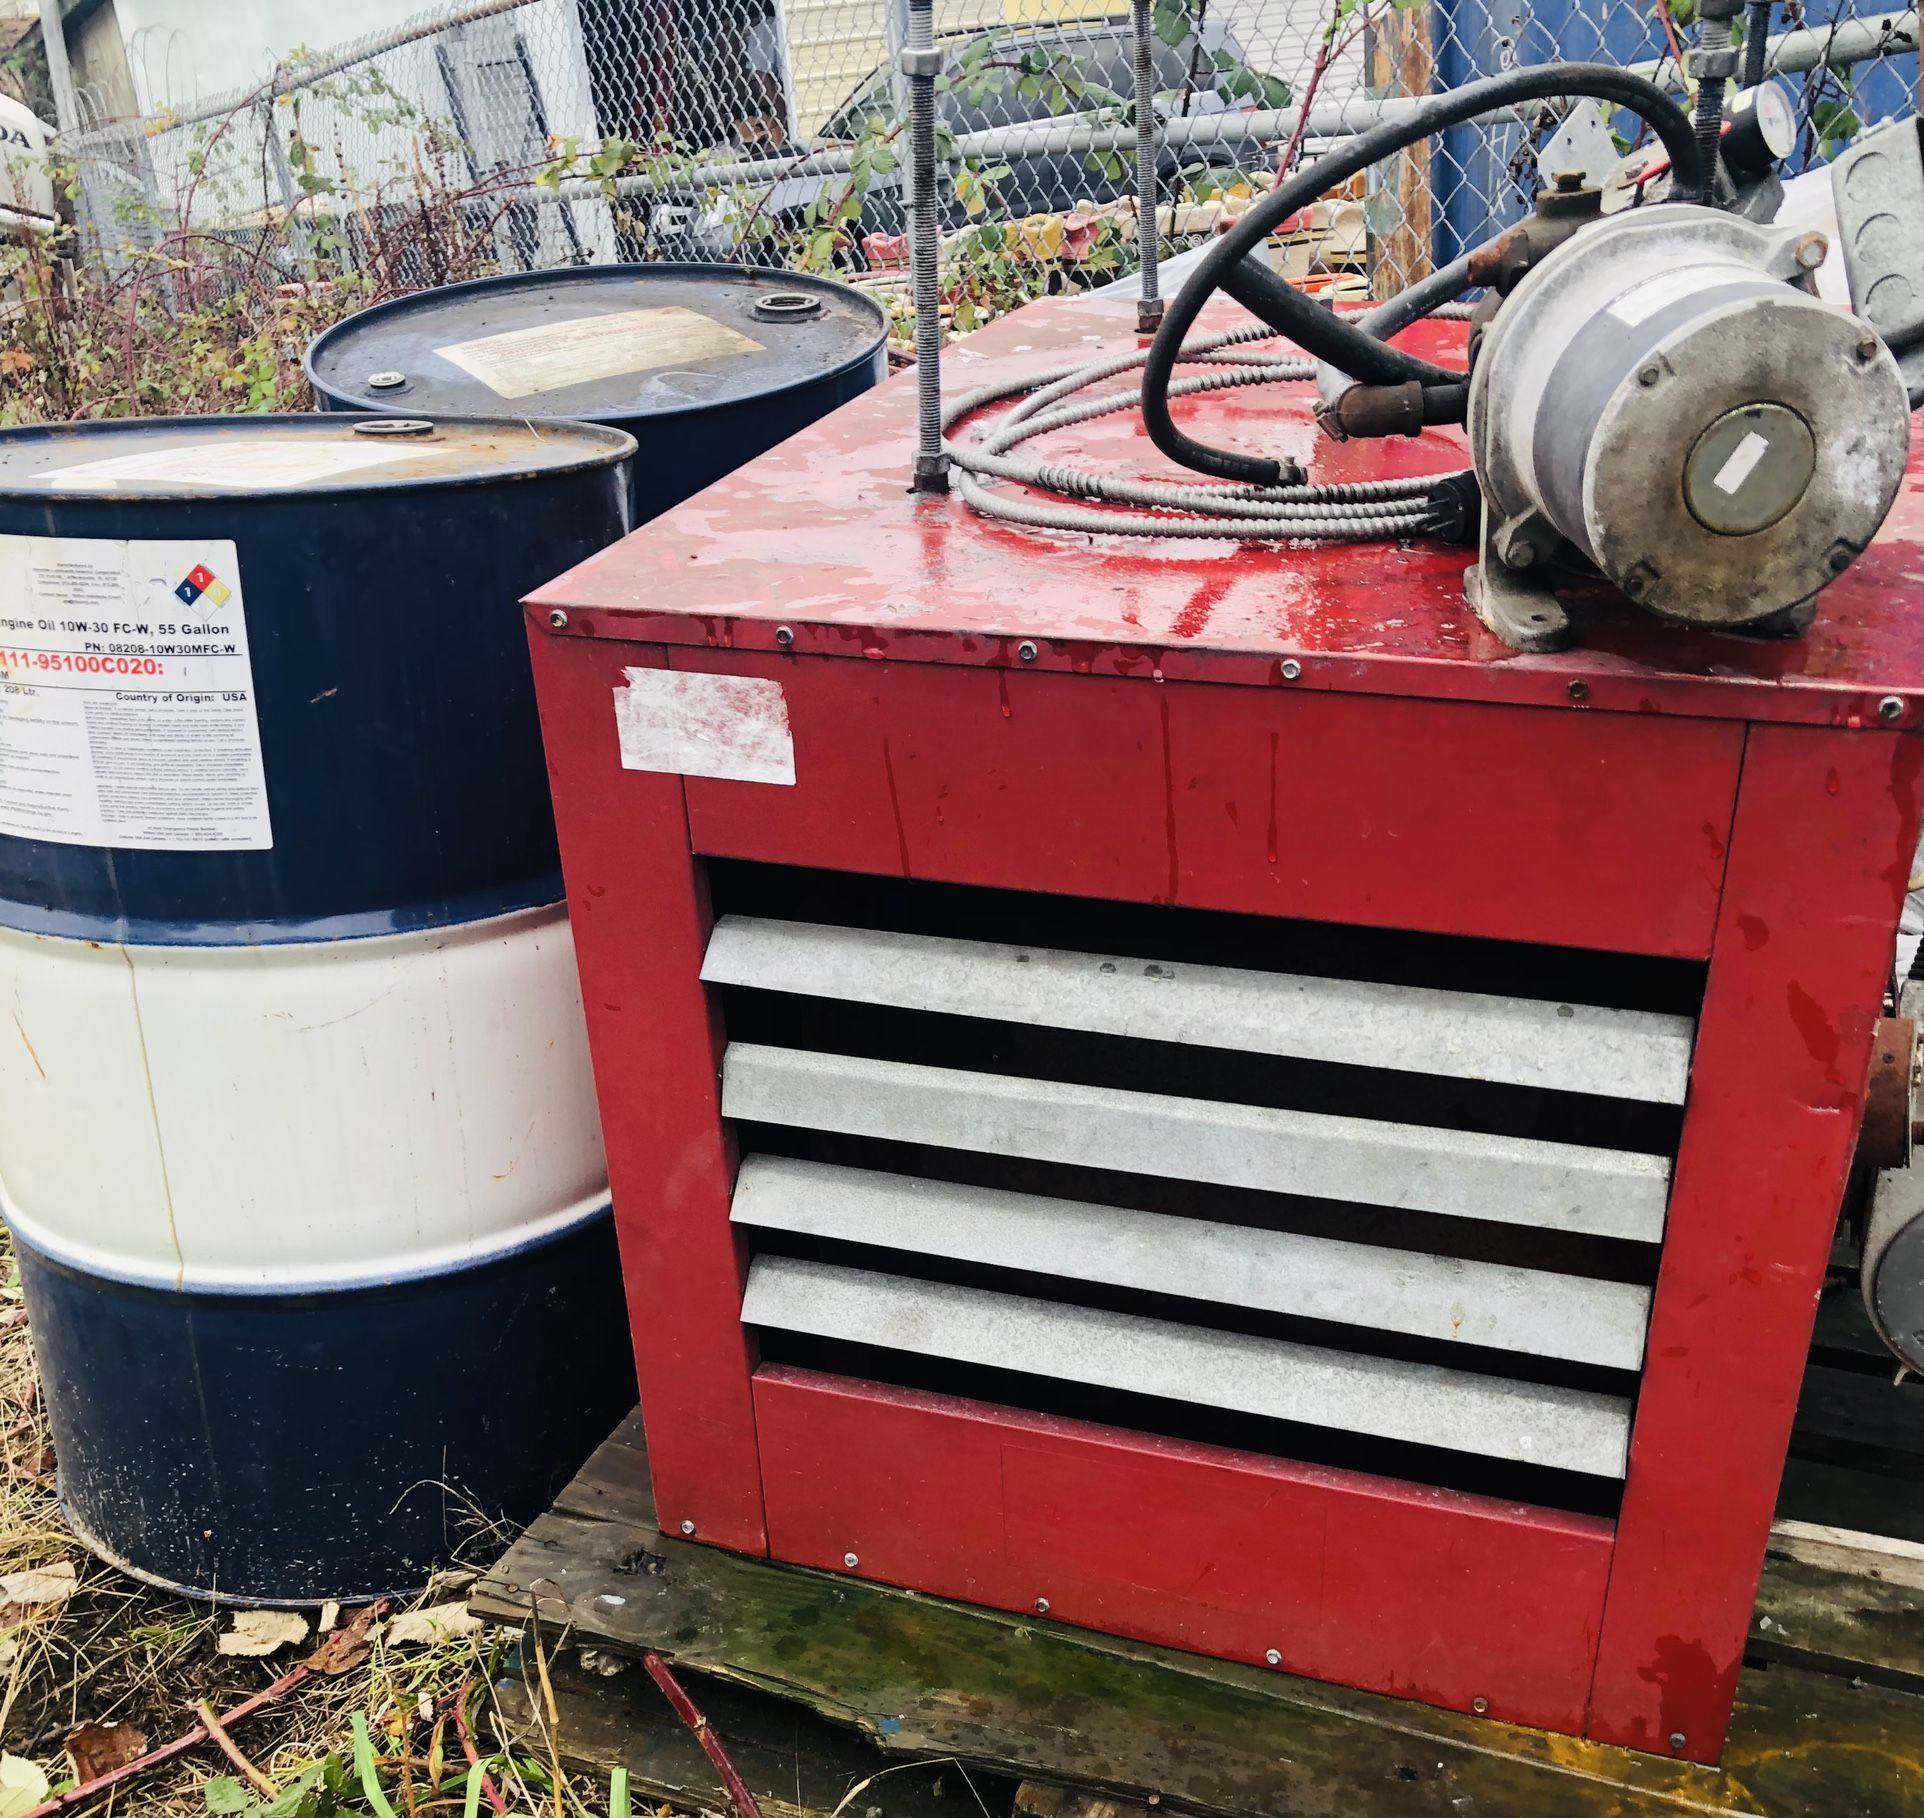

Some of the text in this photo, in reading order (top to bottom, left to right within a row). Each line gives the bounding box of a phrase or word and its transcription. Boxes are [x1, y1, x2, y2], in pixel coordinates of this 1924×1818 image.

[196, 572, 204, 583] 1
[184, 586, 191, 598] 1
[0, 618, 230, 637] ngine Oil 10W-30 FC-W, 55 Gallon
[85, 642, 236, 654] PN: 08208-10W30MFC-W
[115, 692, 248, 704] Country of Origin: USA
